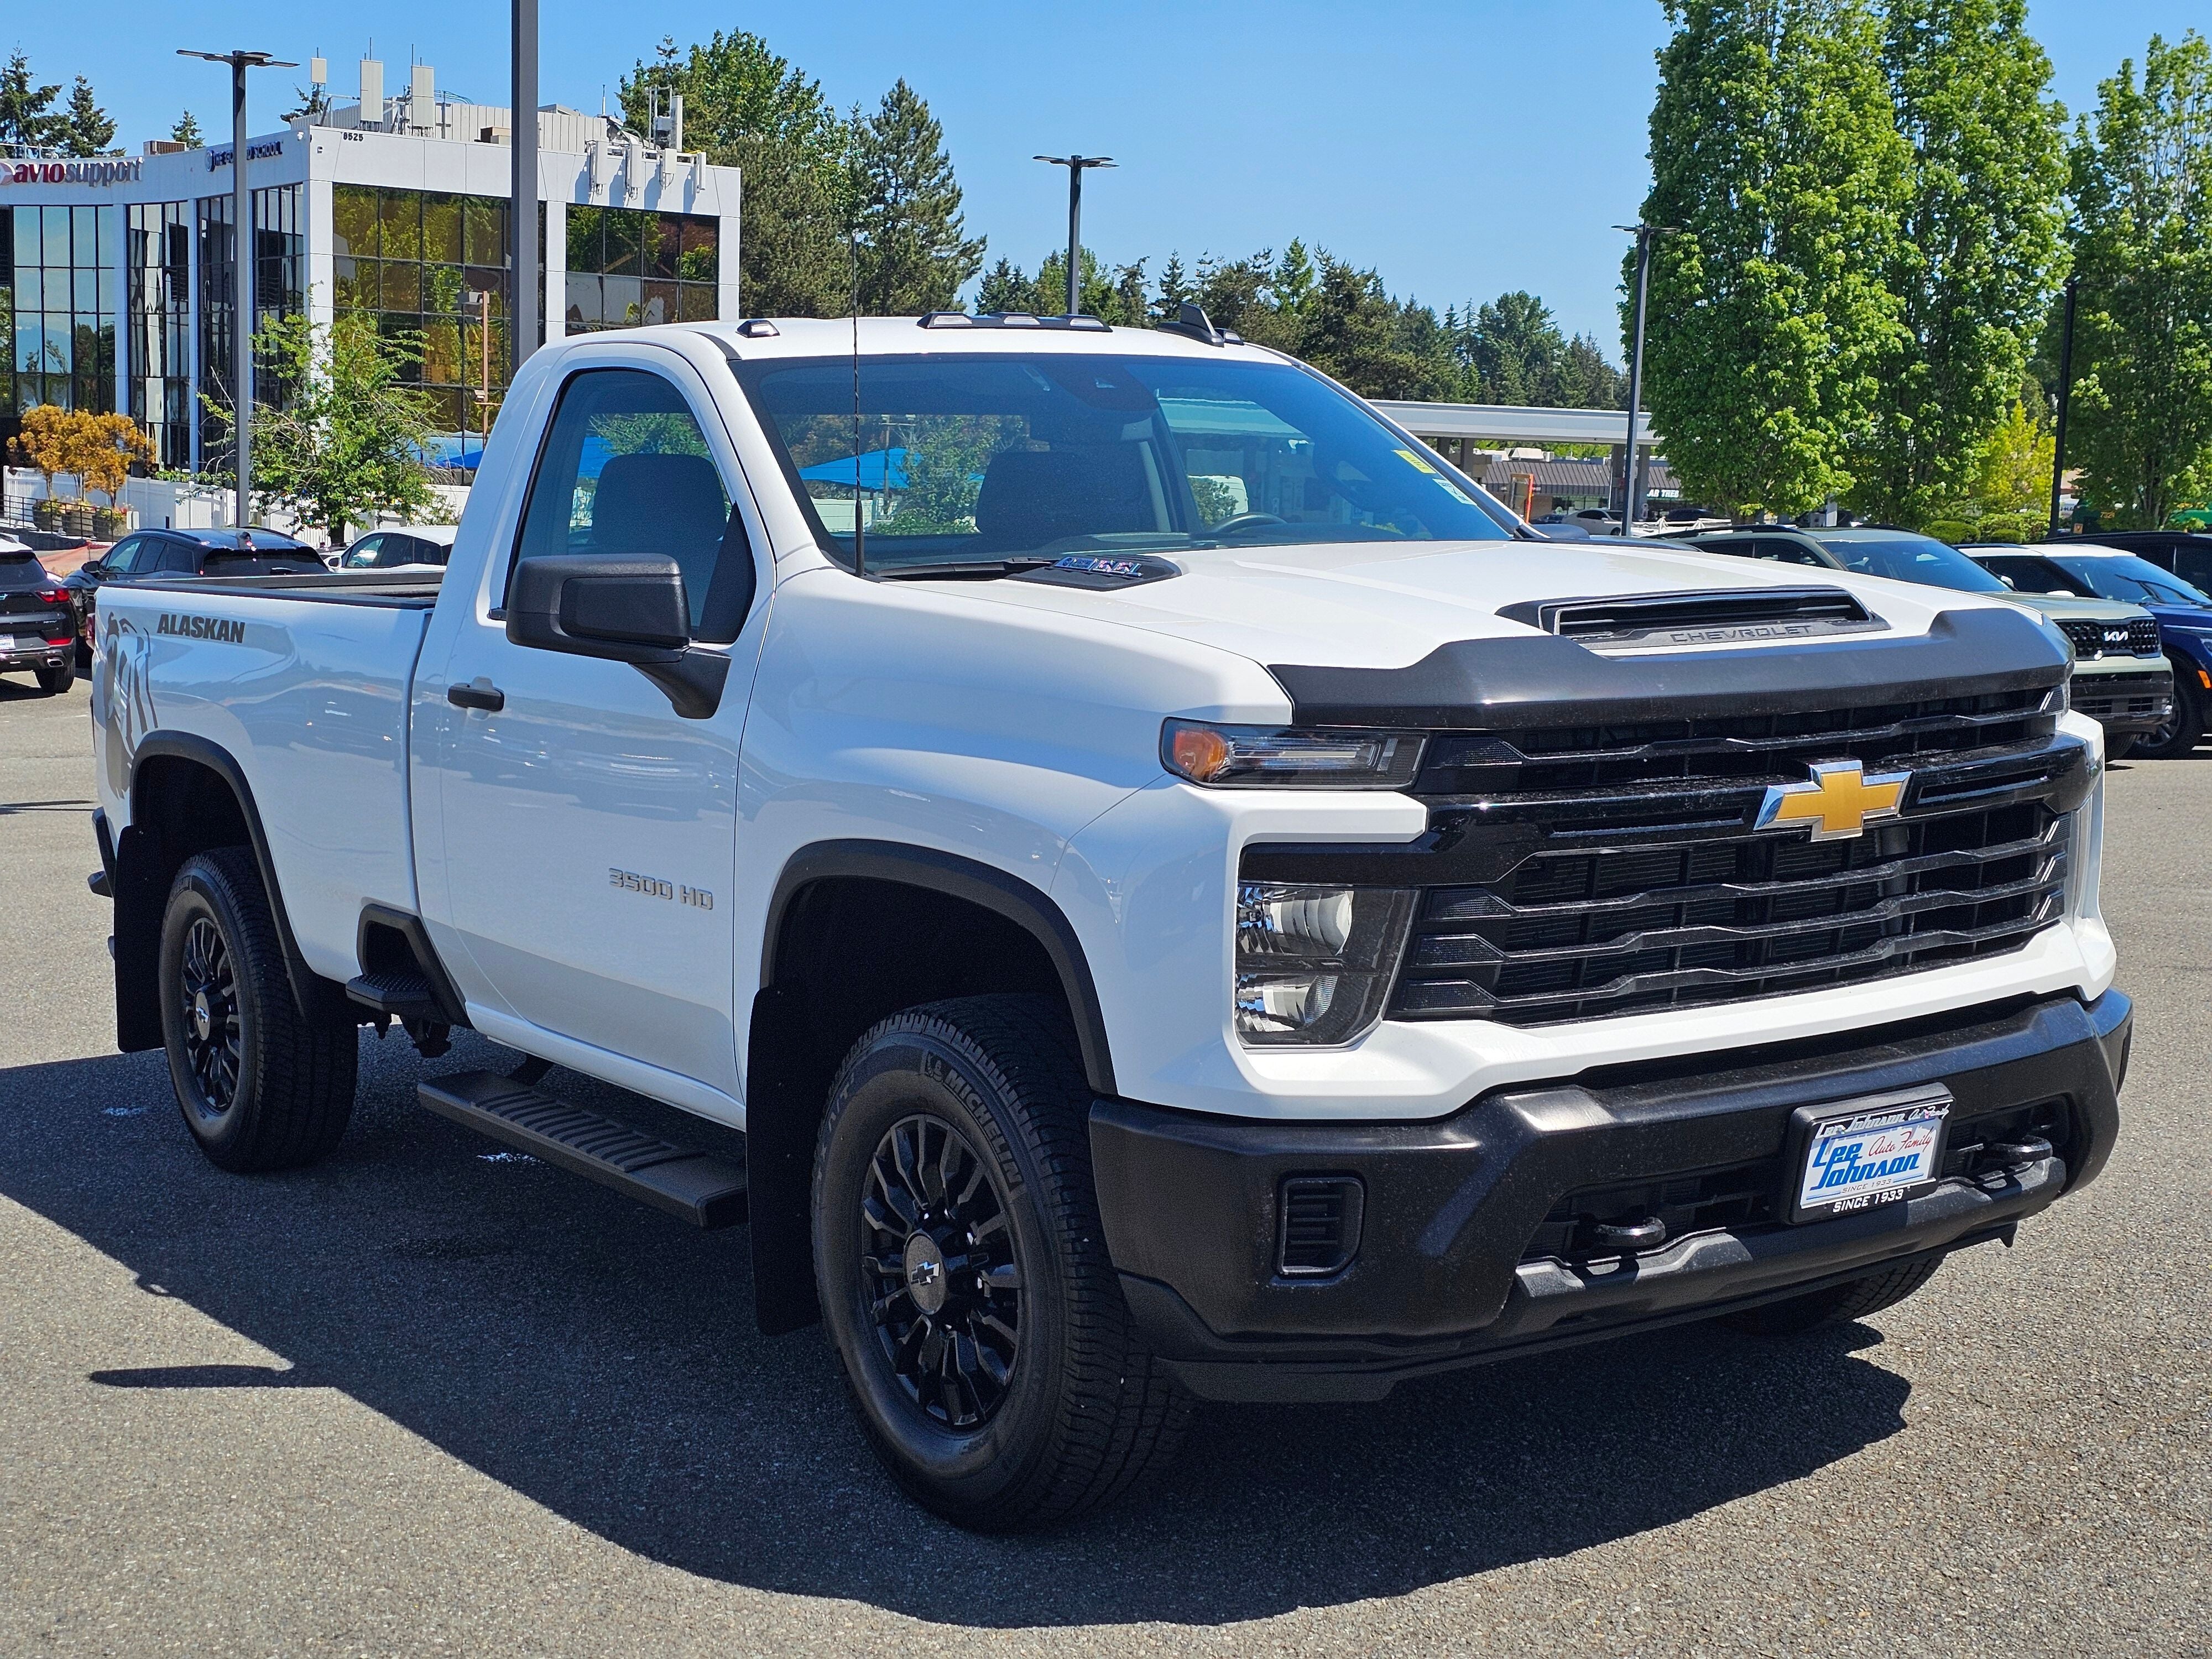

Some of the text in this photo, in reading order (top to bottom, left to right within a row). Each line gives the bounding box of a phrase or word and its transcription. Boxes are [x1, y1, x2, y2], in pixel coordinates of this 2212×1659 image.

[254, 141, 283, 158] SCHOOL
[156, 614, 246, 643] ALASKAN
[1670, 624, 1812, 643] CHEVROLET
[609, 868, 713, 910] 3500 HD
[945, 1068, 1024, 1188] MICHELIN
[1846, 1113, 1905, 1132] Johnson
[1812, 1137, 1863, 1167] Lee
[1869, 1126, 1934, 1156] Auto Family
[1809, 1152, 1921, 1191] Johnson
[1842, 1178, 1892, 1193] SINCE 1933
[1832, 1188, 1903, 1213] SINCE 1933
